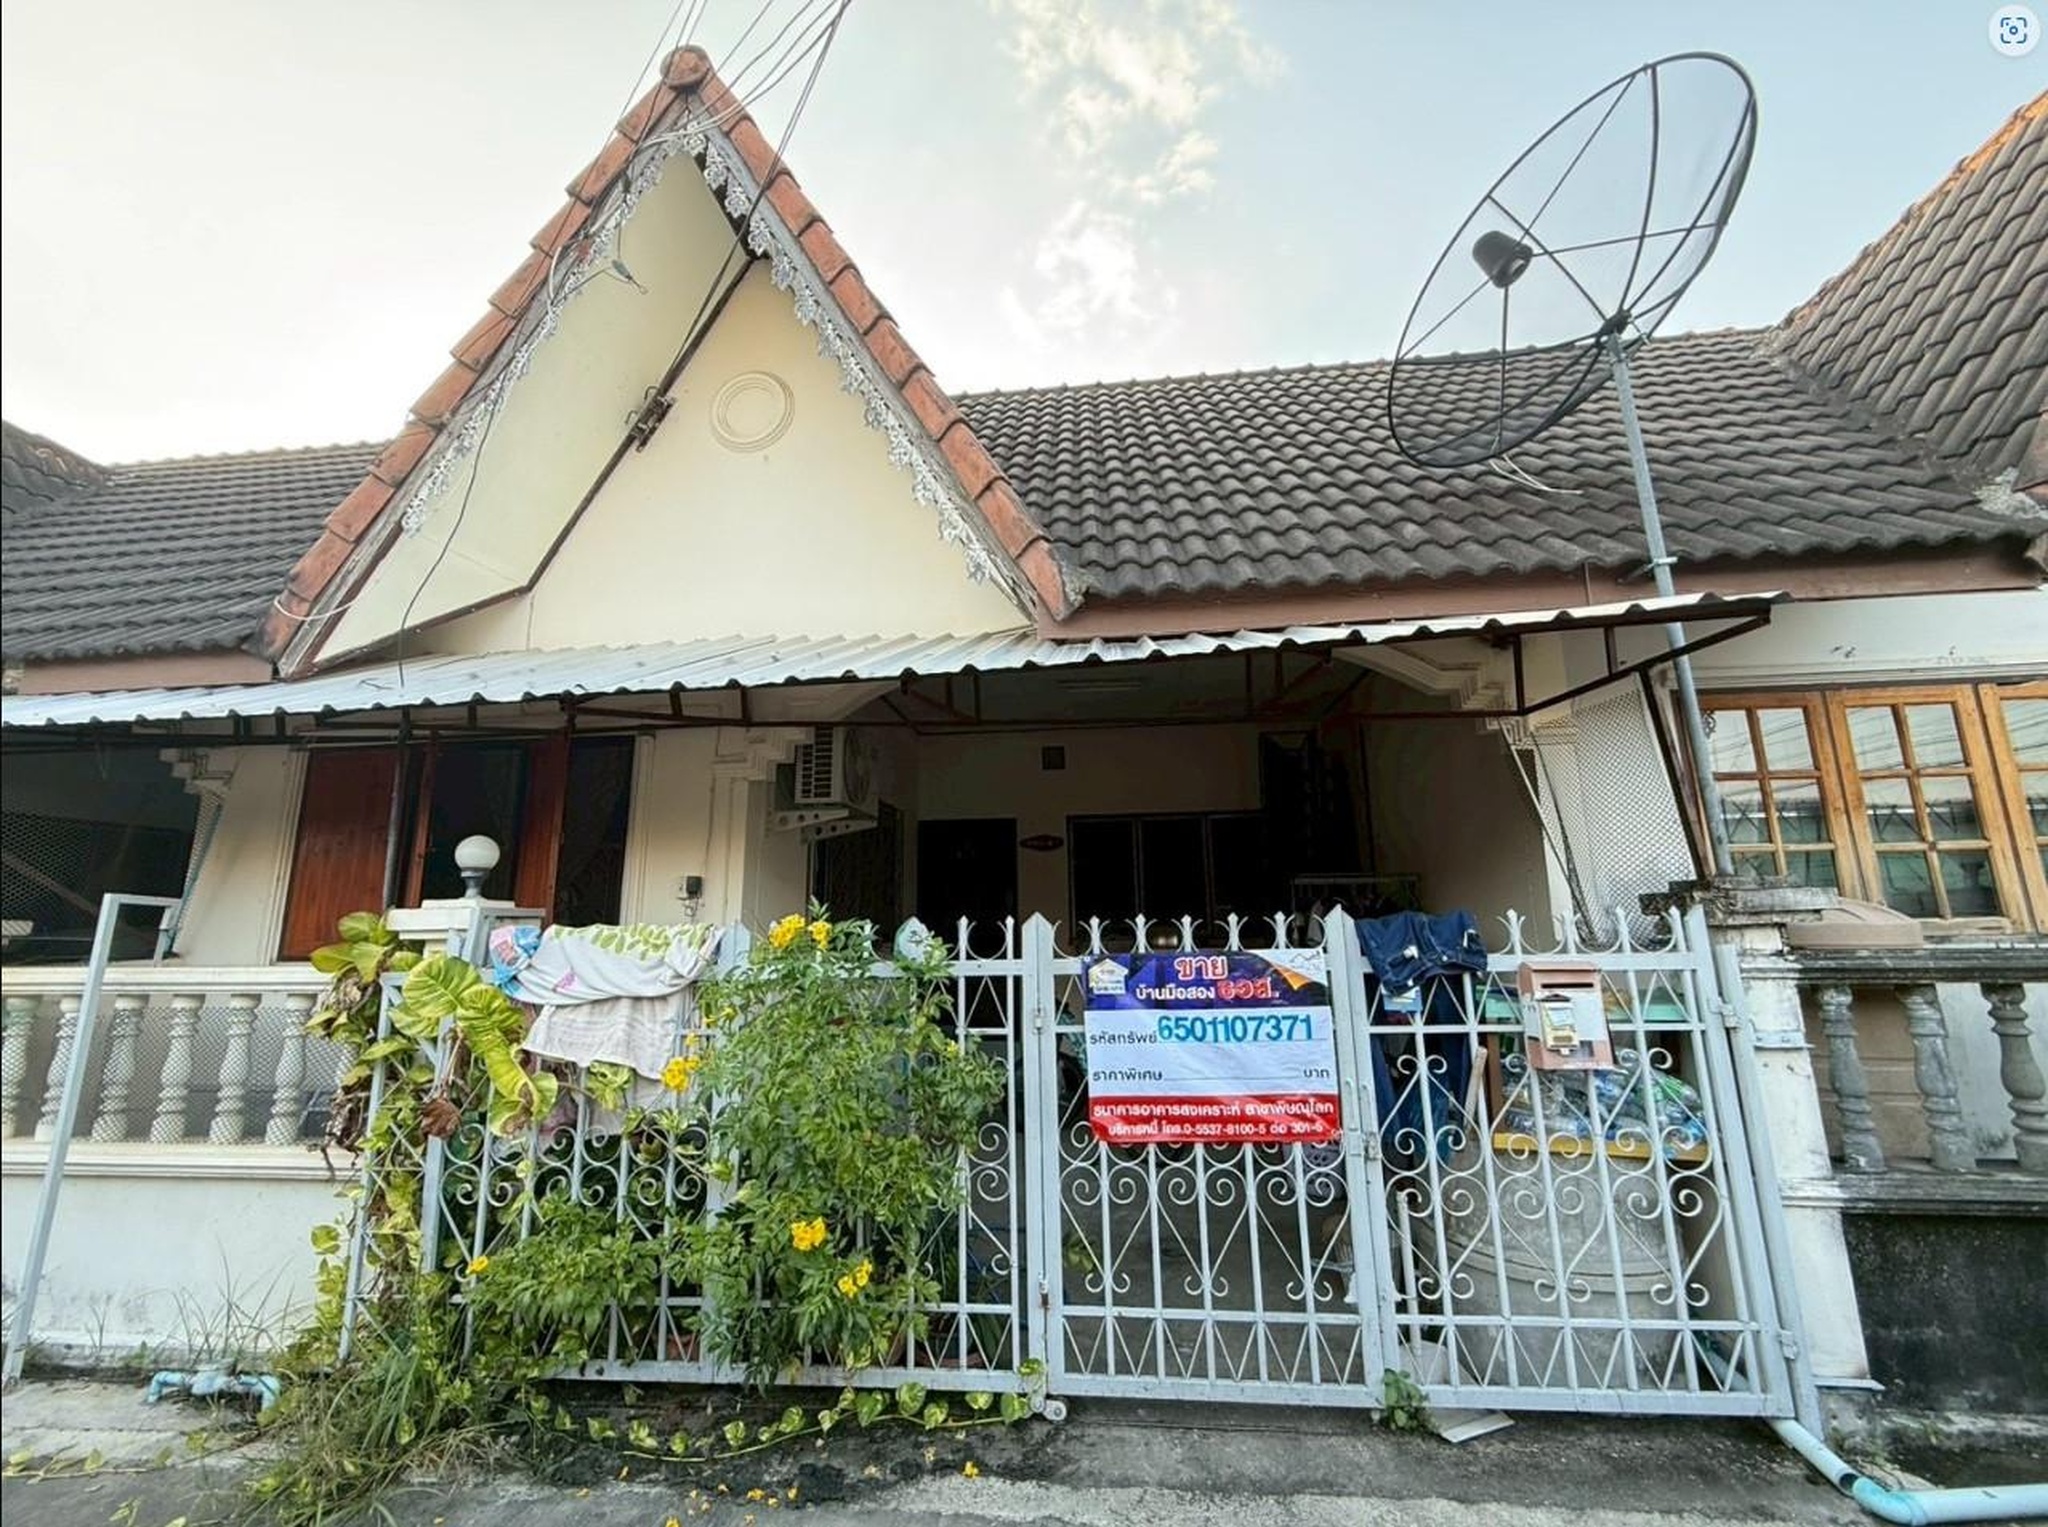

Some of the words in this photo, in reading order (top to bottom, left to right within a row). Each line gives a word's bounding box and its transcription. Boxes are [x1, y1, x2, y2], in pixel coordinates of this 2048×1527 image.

[1174, 956, 1227, 980] ขาย
[1136, 983, 1215, 1000] บ้านมือสอง
[1158, 1014, 1312, 1043] 6501107371
[1093, 1067, 1163, 1081] ราคาพิเศษ
[1303, 1068, 1330, 1079] บาท
